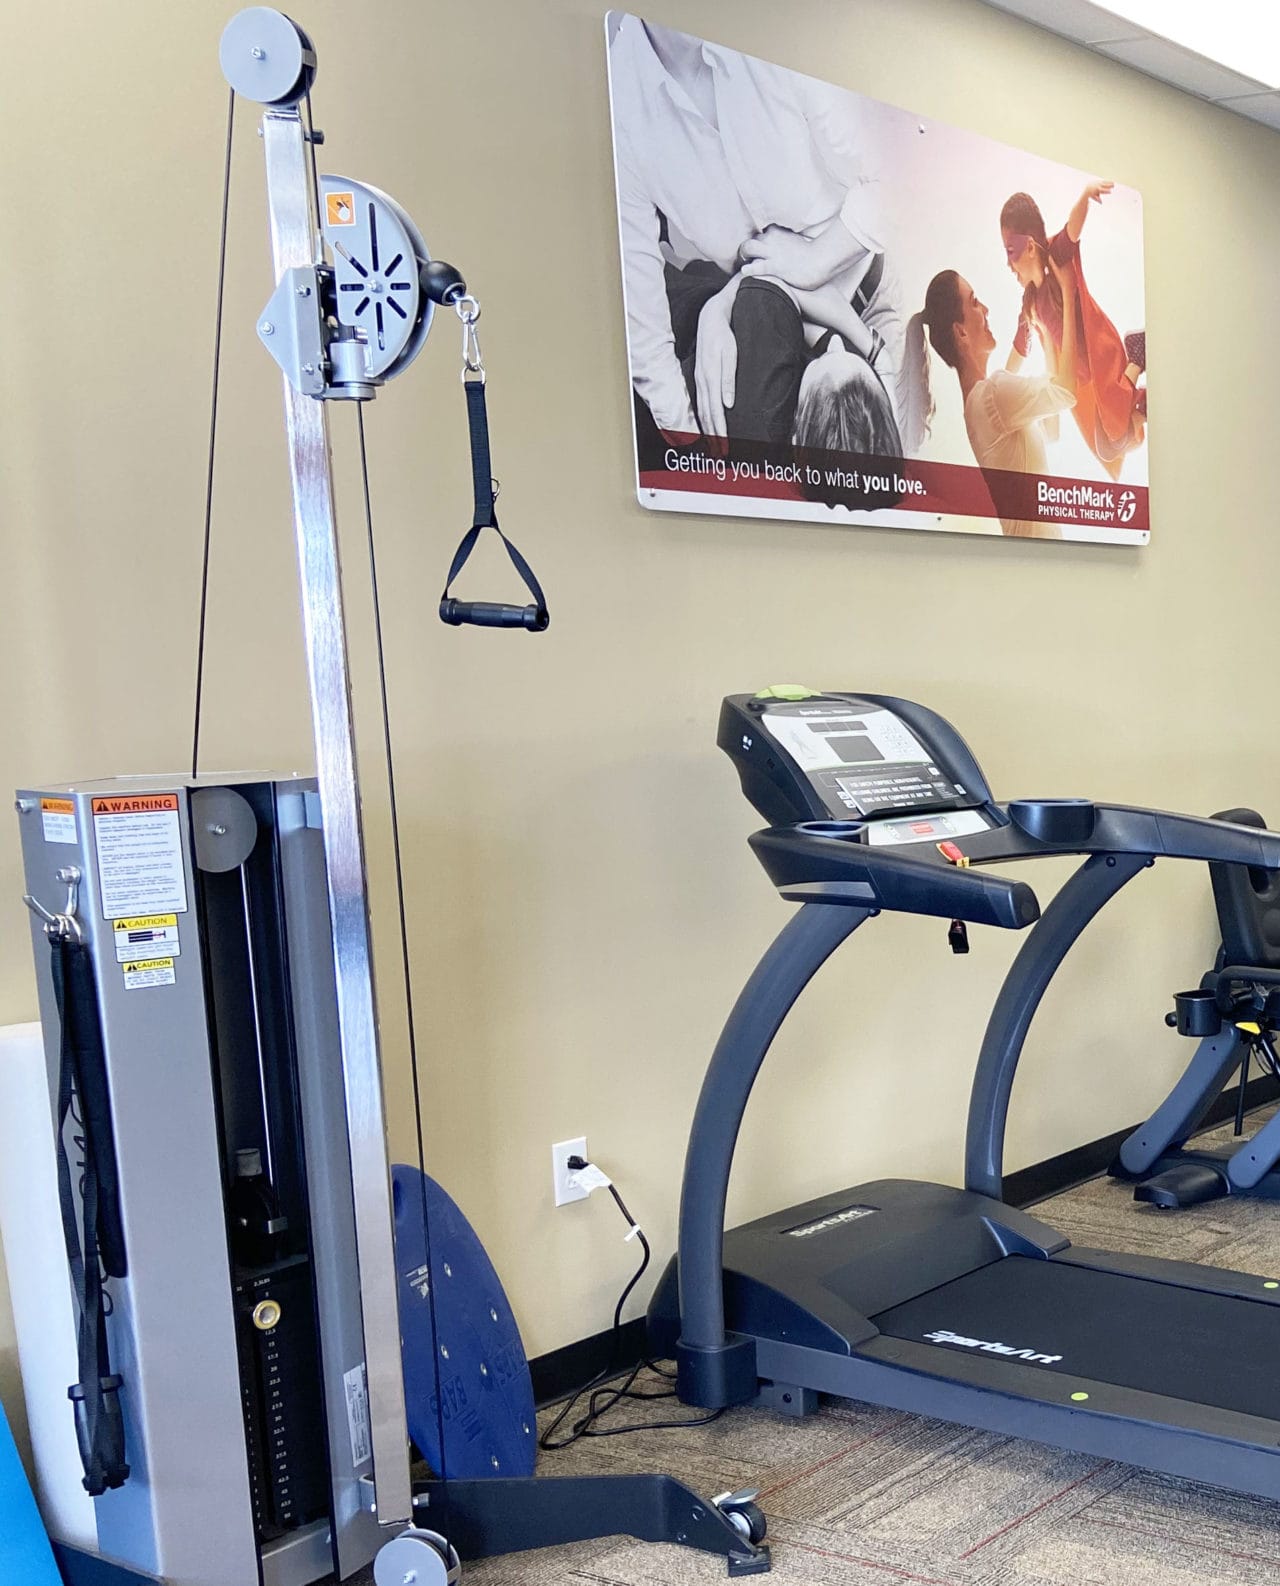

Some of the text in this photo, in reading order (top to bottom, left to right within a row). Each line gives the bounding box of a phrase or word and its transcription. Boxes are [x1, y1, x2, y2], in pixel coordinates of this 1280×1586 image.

[664, 449, 927, 496] Getting you back to what you love.
[1038, 481, 1115, 509] BenchMark
[1038, 505, 1115, 521] PHYSICAL THERAPY
[111, 799, 172, 811] WARNING
[127, 918, 168, 927] CAUTION
[136, 960, 171, 968] CAUTION
[922, 1330, 1065, 1364] SportsArt
